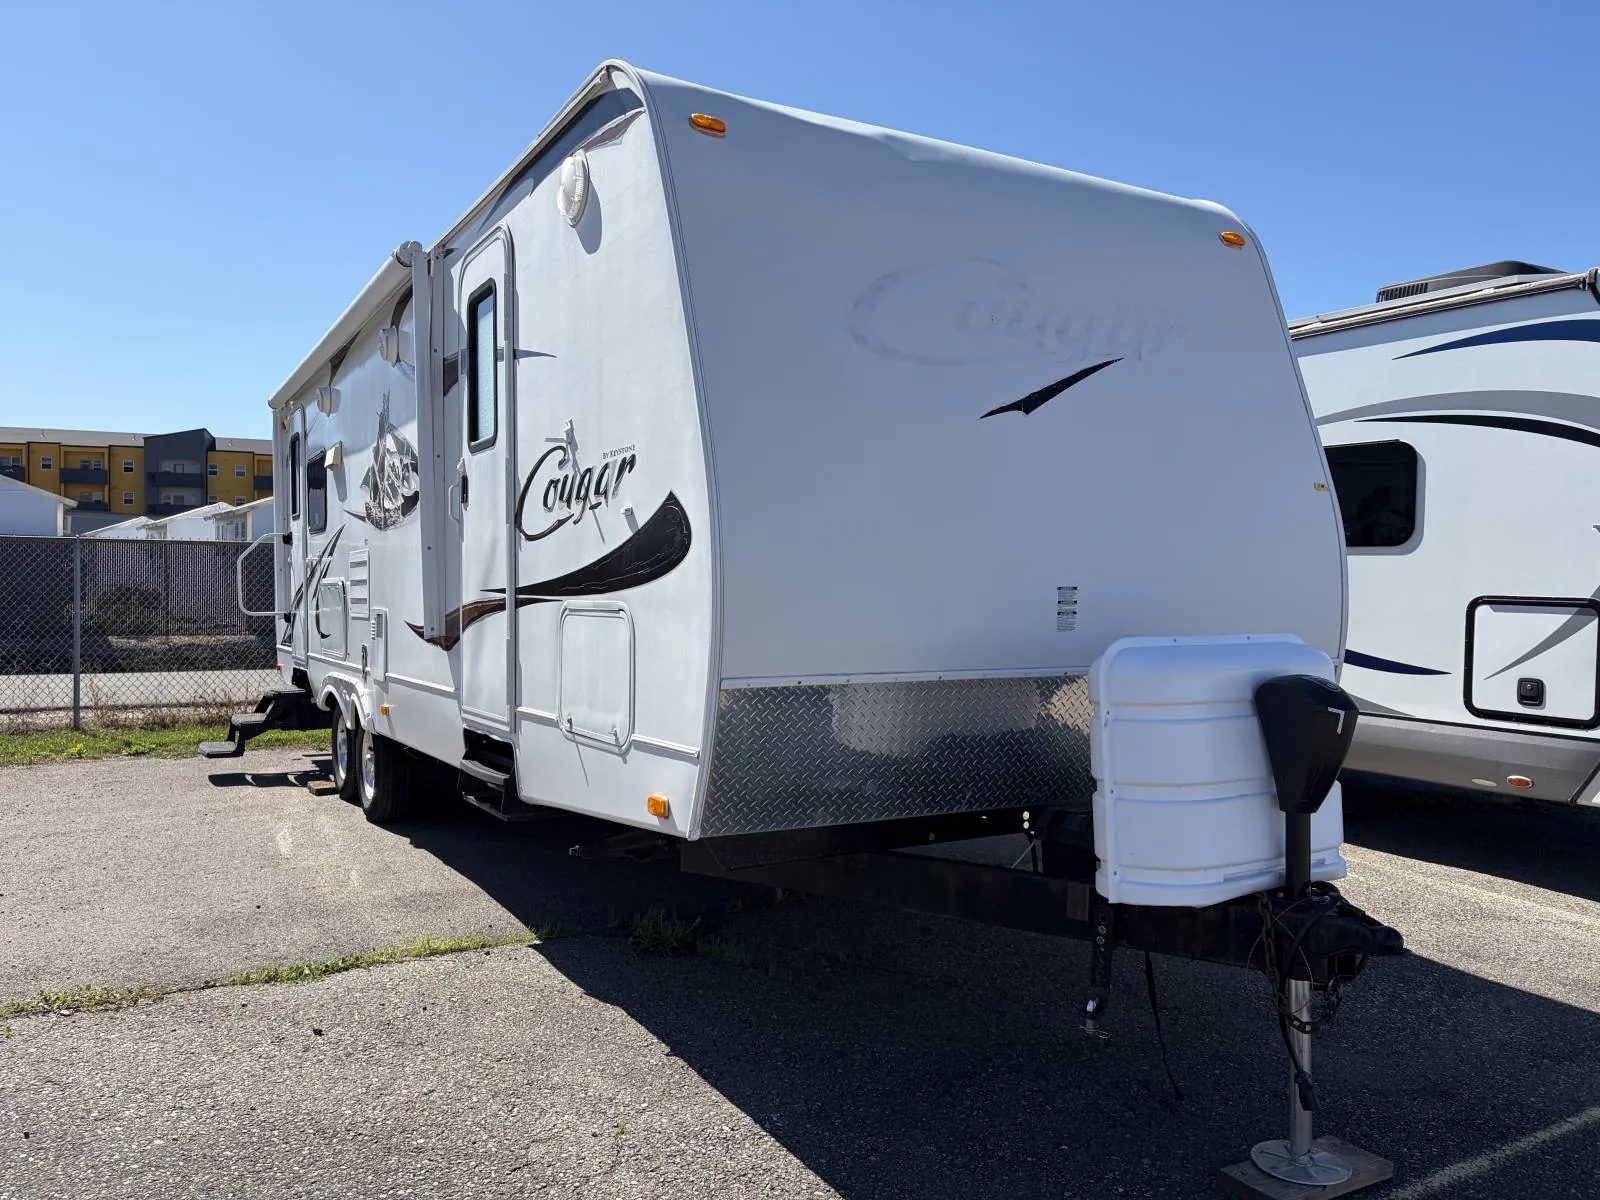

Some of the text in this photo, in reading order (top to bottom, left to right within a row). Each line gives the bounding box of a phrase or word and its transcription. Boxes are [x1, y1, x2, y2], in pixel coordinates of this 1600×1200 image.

[602, 444, 636, 460] BY KEYSTONE
[515, 445, 637, 541] Cougar
